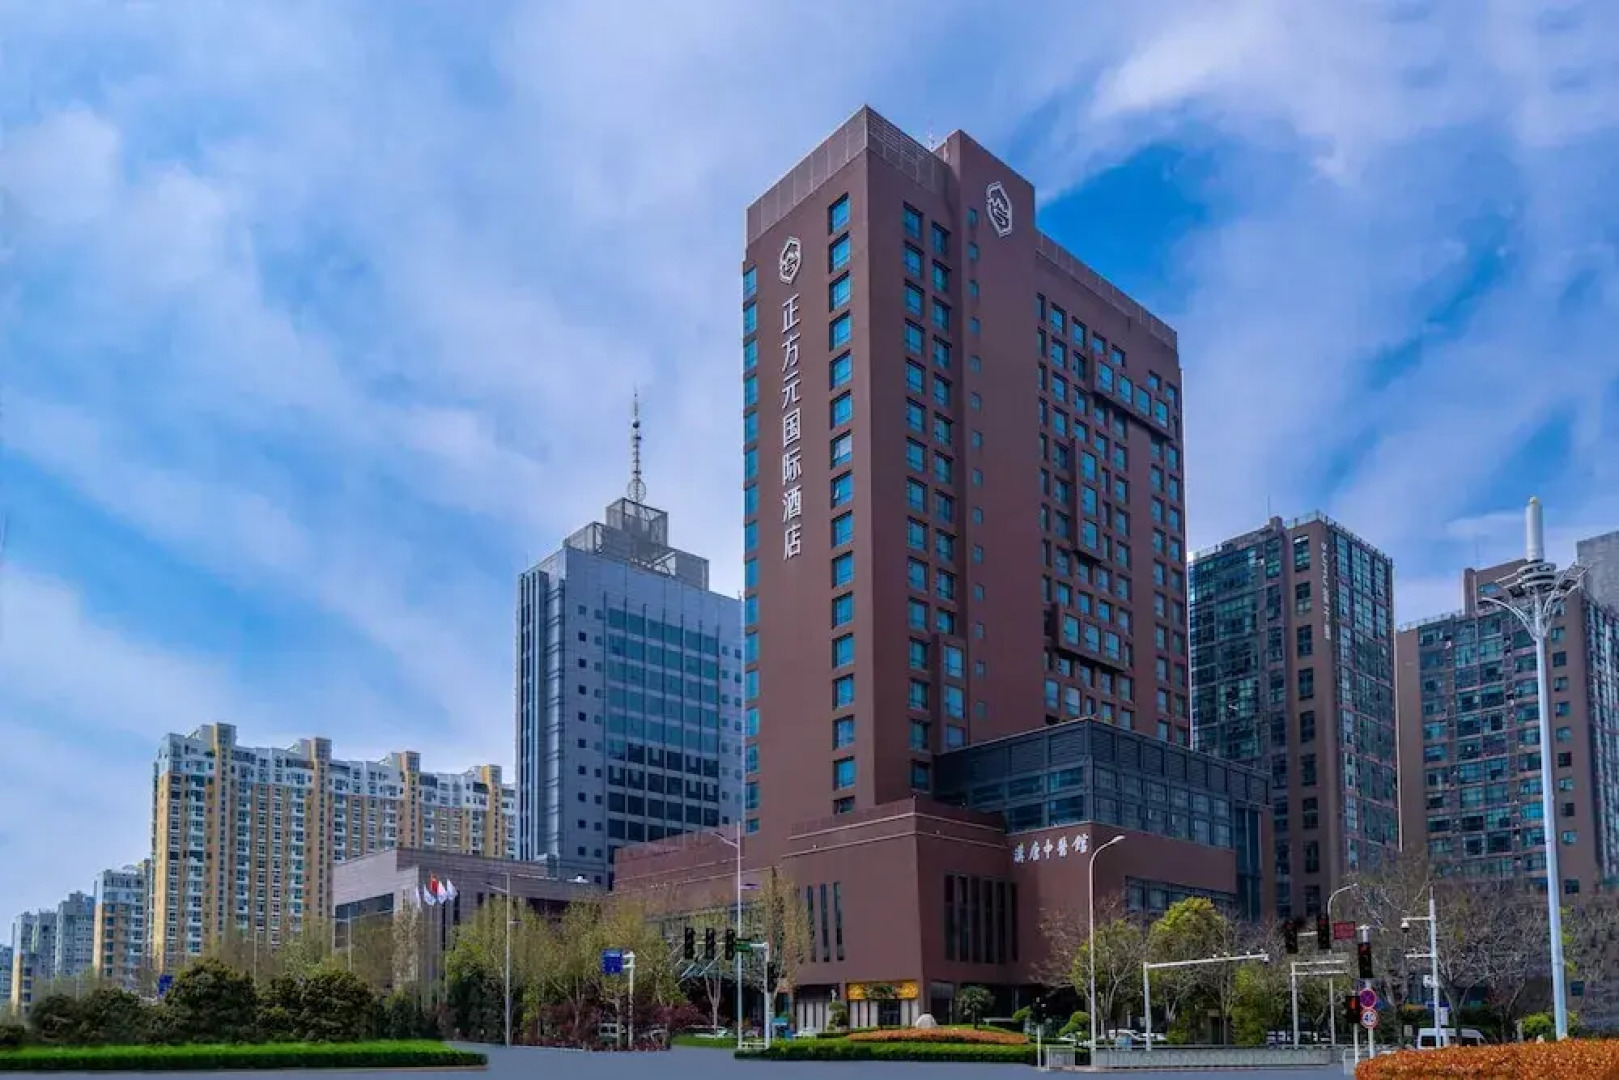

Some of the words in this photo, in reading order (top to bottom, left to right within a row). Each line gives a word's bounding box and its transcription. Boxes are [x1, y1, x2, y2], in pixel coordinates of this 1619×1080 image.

[781, 293, 802, 560] 正方元国际酒店
